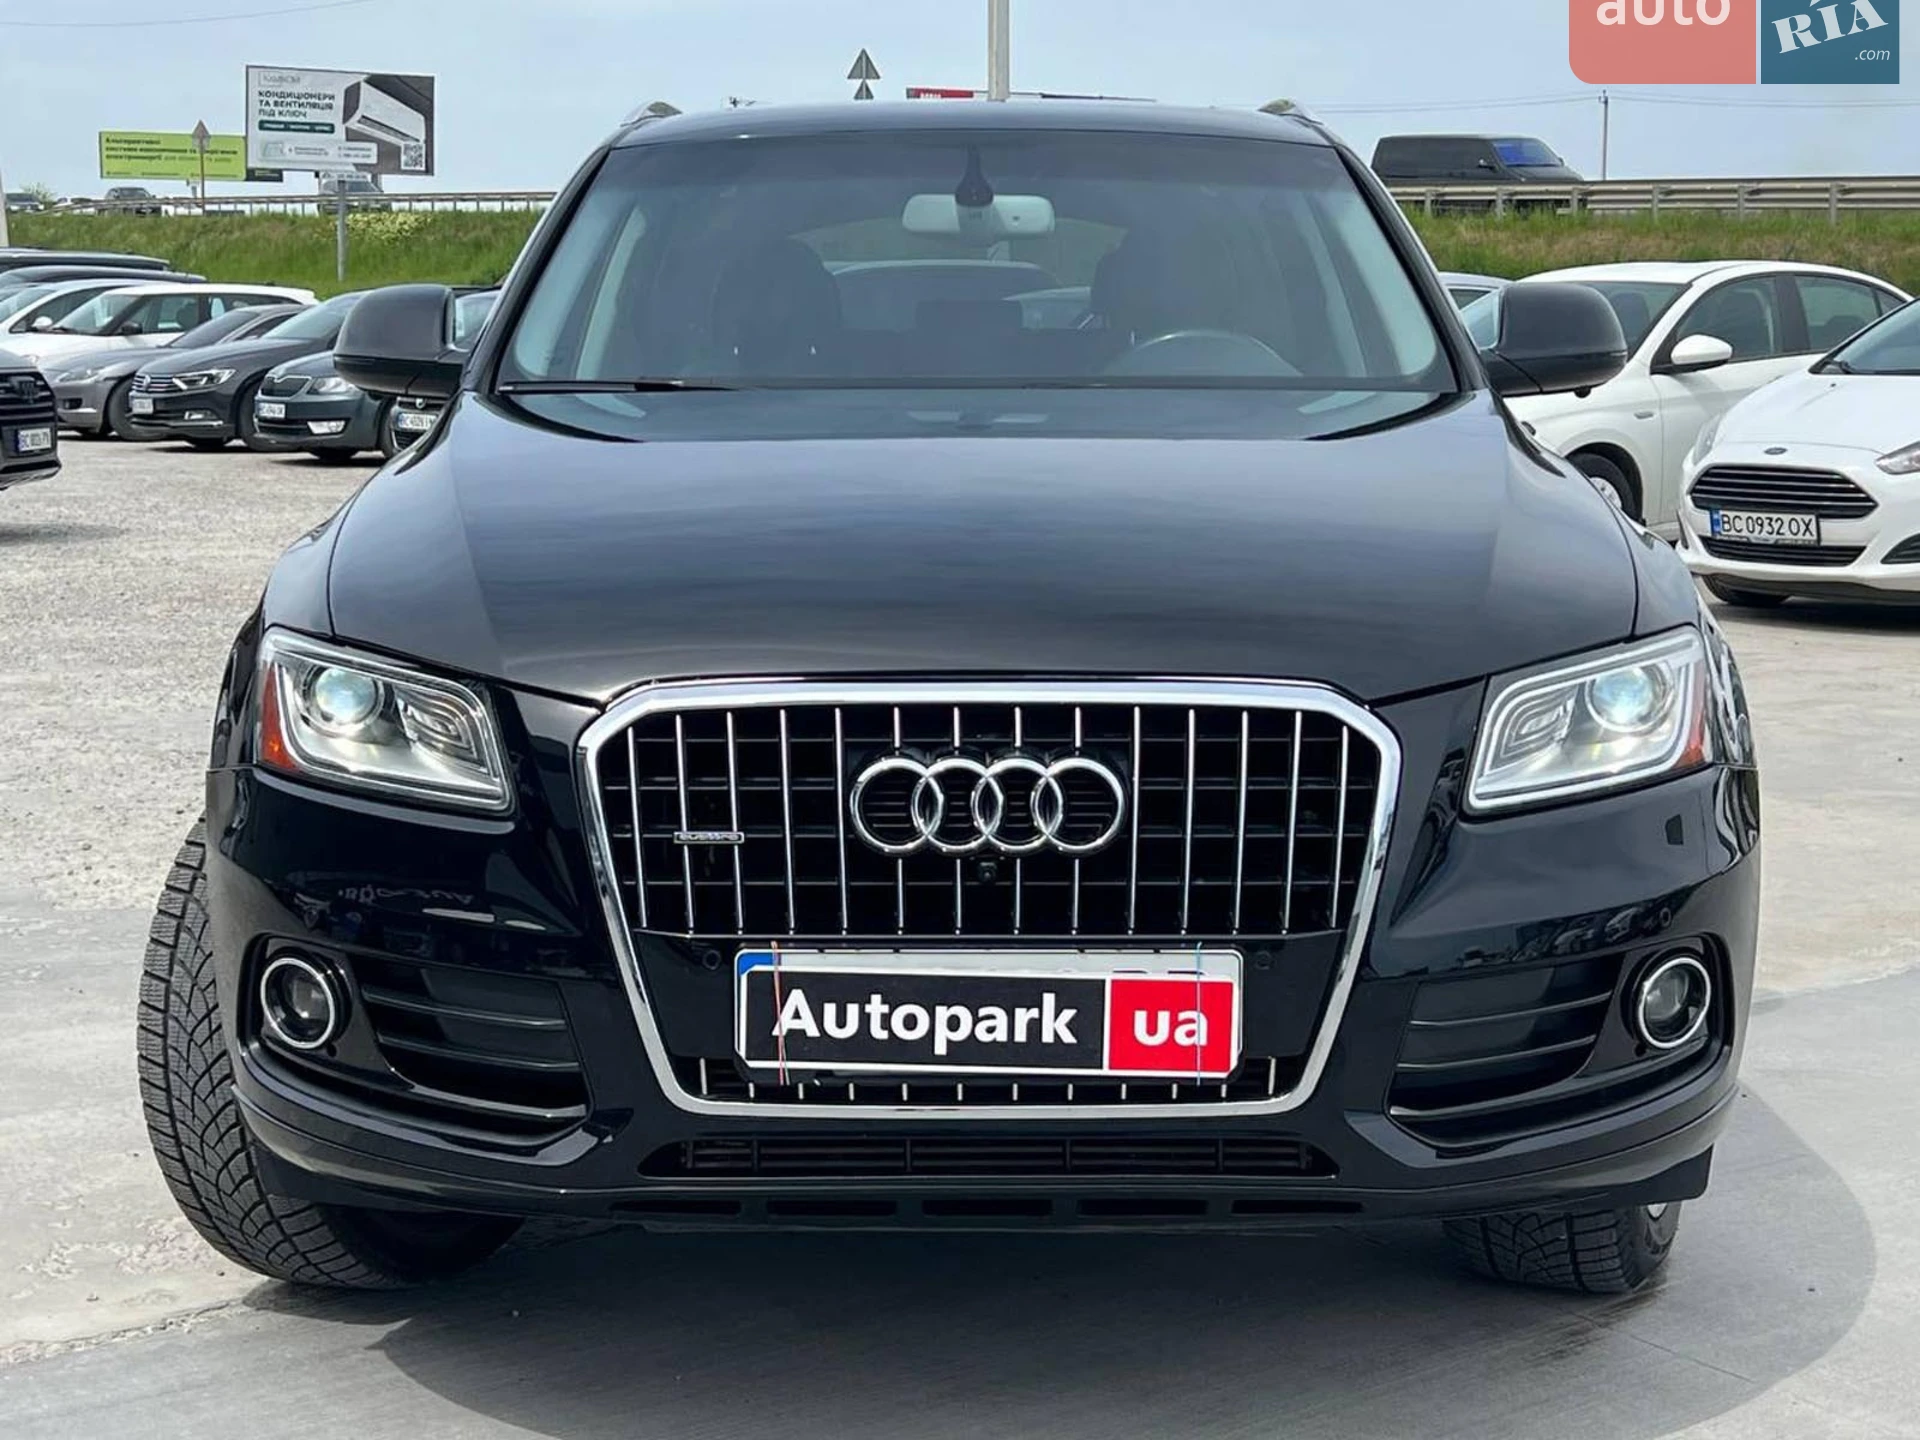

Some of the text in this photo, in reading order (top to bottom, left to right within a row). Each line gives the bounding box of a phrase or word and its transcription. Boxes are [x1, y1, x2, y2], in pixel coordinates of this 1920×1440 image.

[259, 99, 271, 108] ТА
[258, 109, 307, 119] ПІД КЛЮЧ
[1745, 516, 1785, 536] 0932
[772, 988, 1208, 1055] Autopark ua
